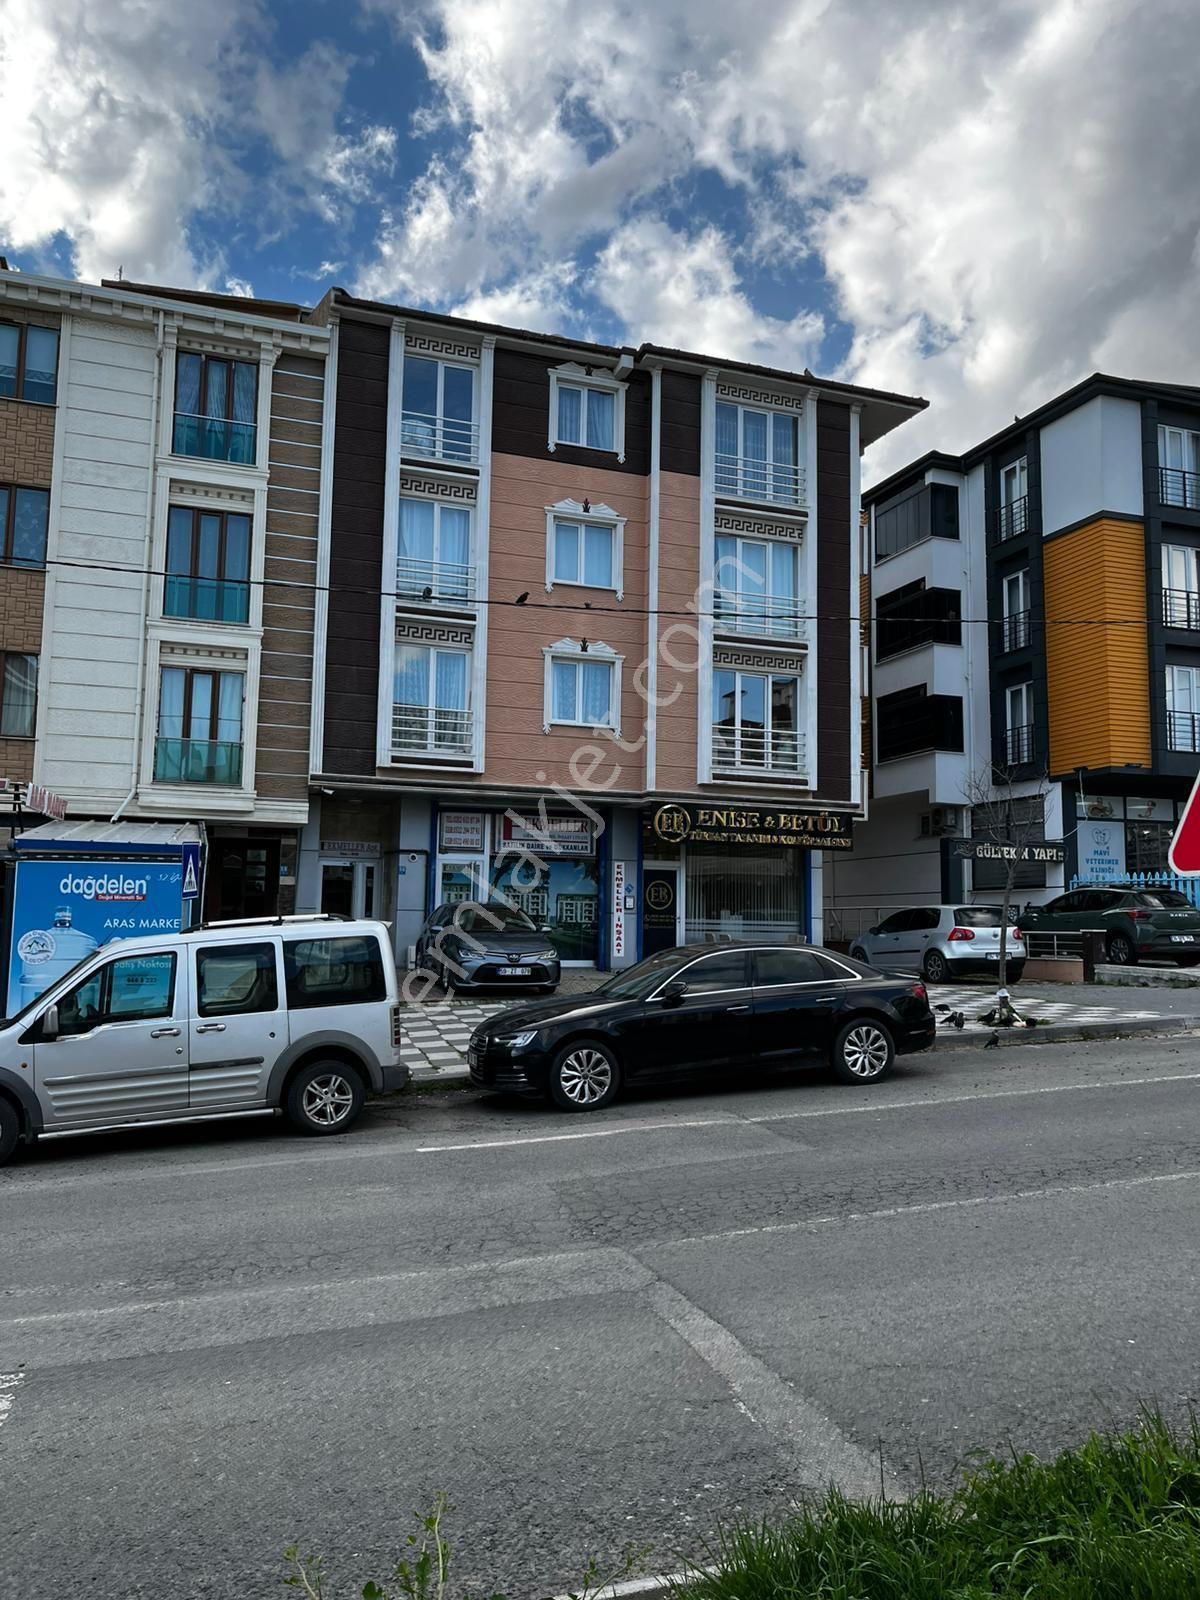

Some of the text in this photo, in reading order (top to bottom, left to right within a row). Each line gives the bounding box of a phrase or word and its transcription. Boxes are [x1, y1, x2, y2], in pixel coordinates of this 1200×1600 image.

[764, 816, 775, 828] &
[777, 809, 845, 833] BETÜL
[976, 843, 1029, 860] GÜLTEKN
[1032, 848, 1057, 860] YAPI
[60, 873, 147, 899] dağdelen
[615, 864, 623, 913] EKMELLER
[103, 918, 182, 929] ARAS MARKE
